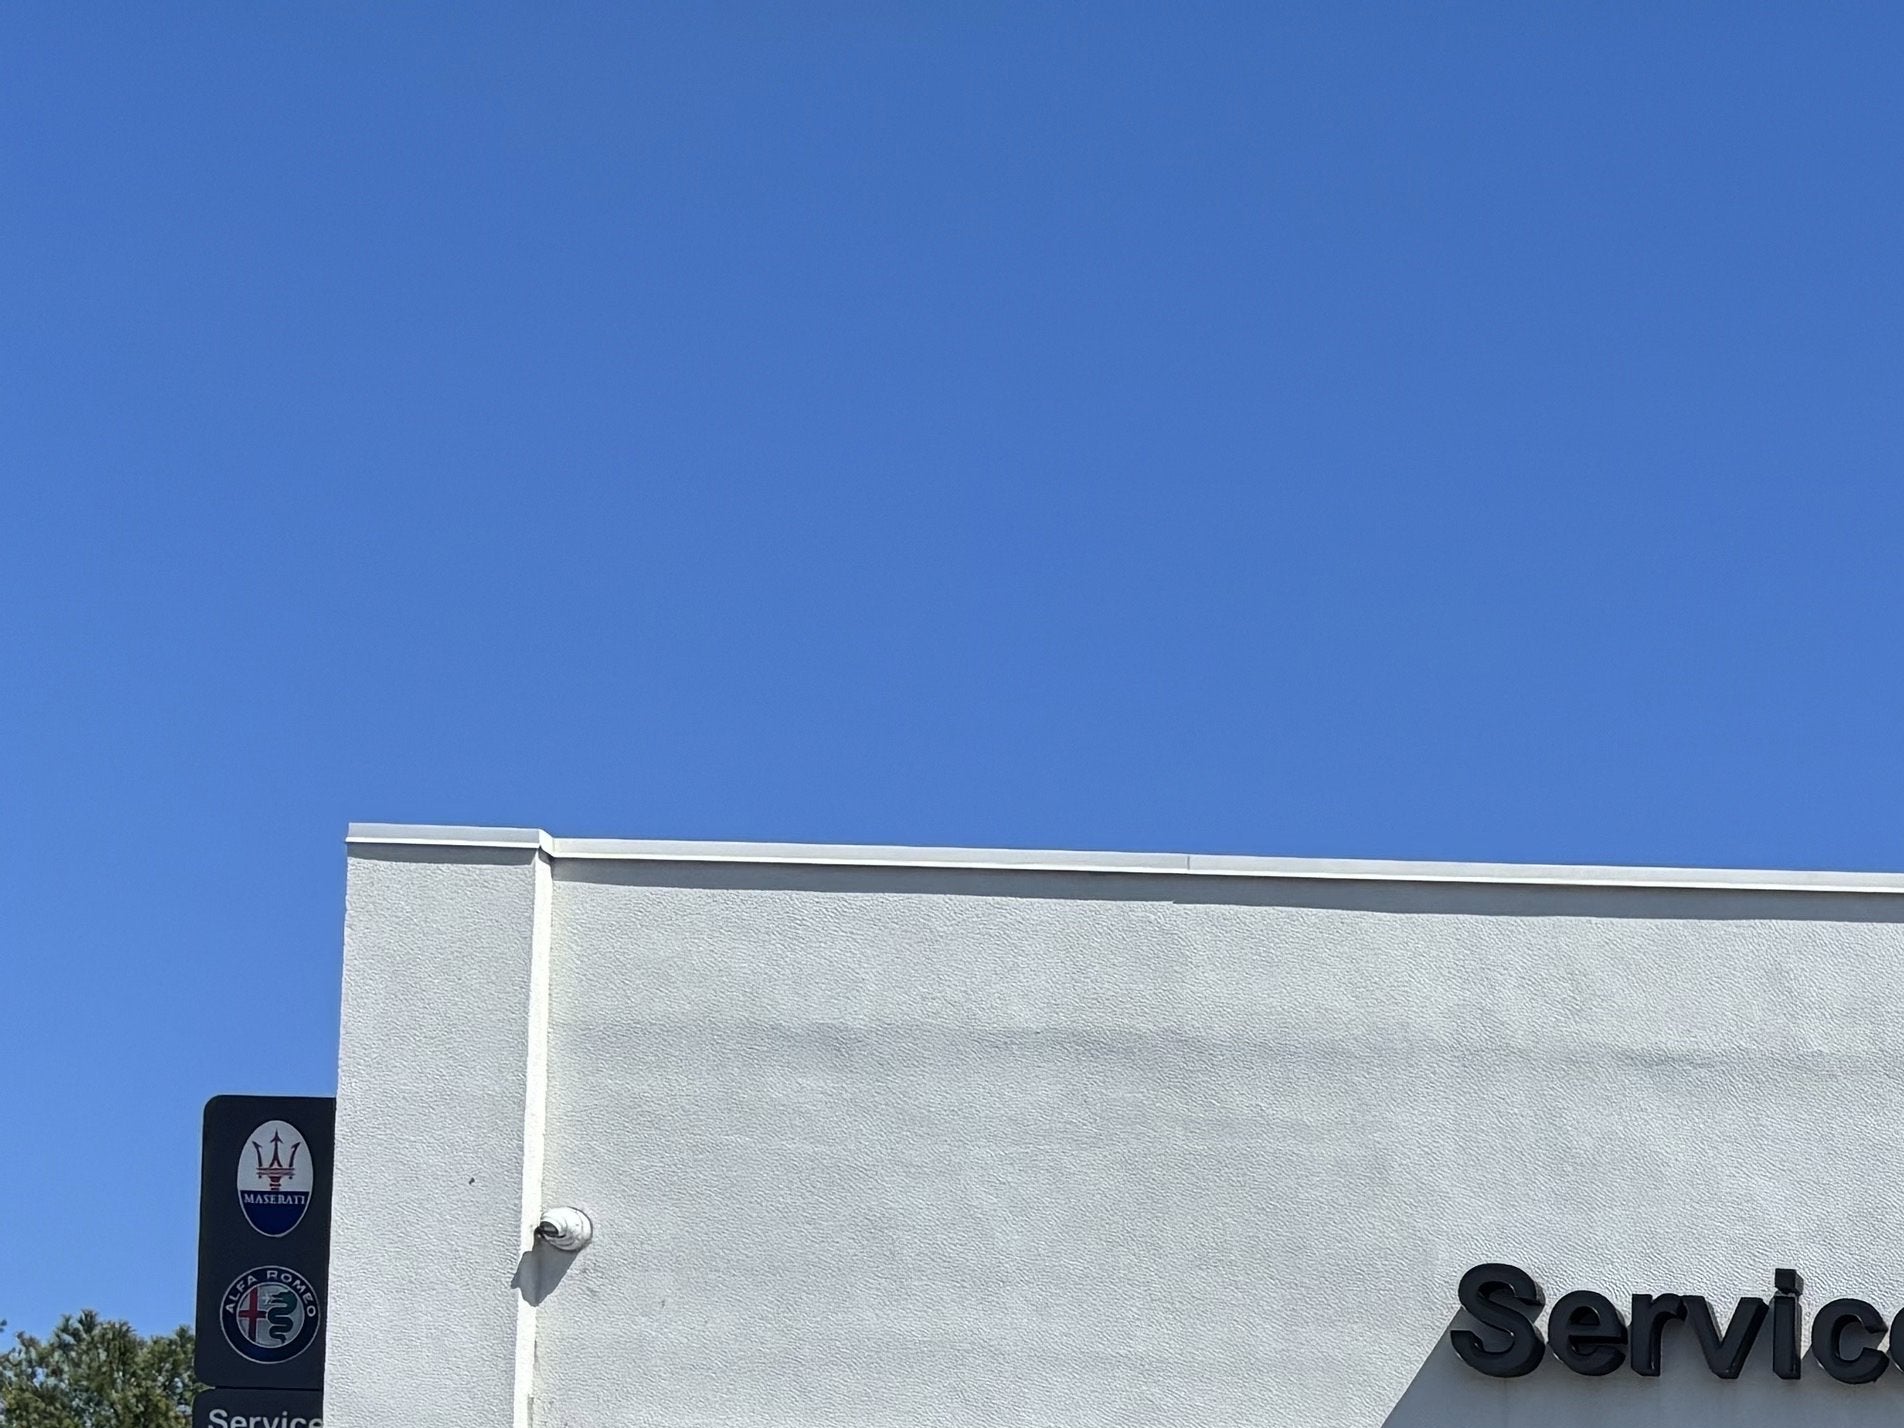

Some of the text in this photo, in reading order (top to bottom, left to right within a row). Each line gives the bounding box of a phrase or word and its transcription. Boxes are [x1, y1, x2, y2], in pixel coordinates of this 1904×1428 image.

[244, 1193, 306, 1206] MASERATI
[225, 1269, 318, 1318] ALFA ROMEO
